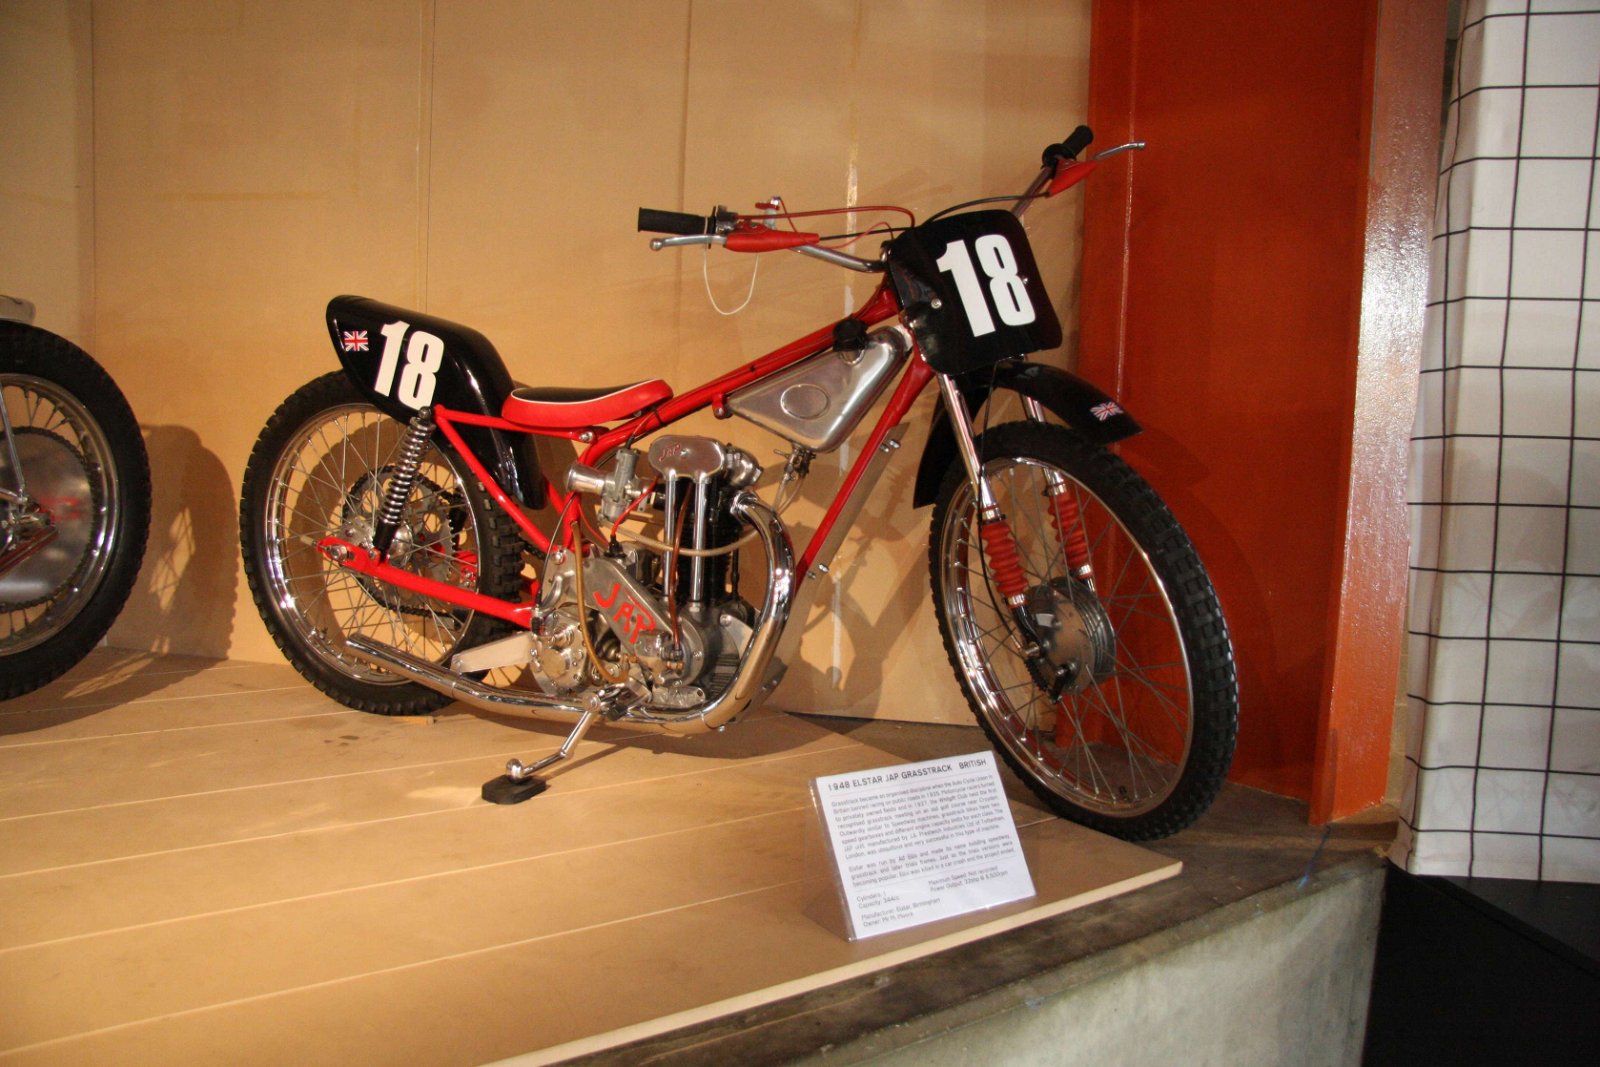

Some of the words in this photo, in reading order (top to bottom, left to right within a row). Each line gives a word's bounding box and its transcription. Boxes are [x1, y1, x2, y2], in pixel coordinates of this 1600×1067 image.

[936, 234, 1035, 337] 18
[374, 320, 444, 411] 18
[593, 582, 656, 644] JAP
[828, 782, 850, 790] 1948
[853, 776, 882, 786] ELSTAR
[901, 765, 952, 778] GRASSTRACK
[959, 759, 986, 769] BRITISH
